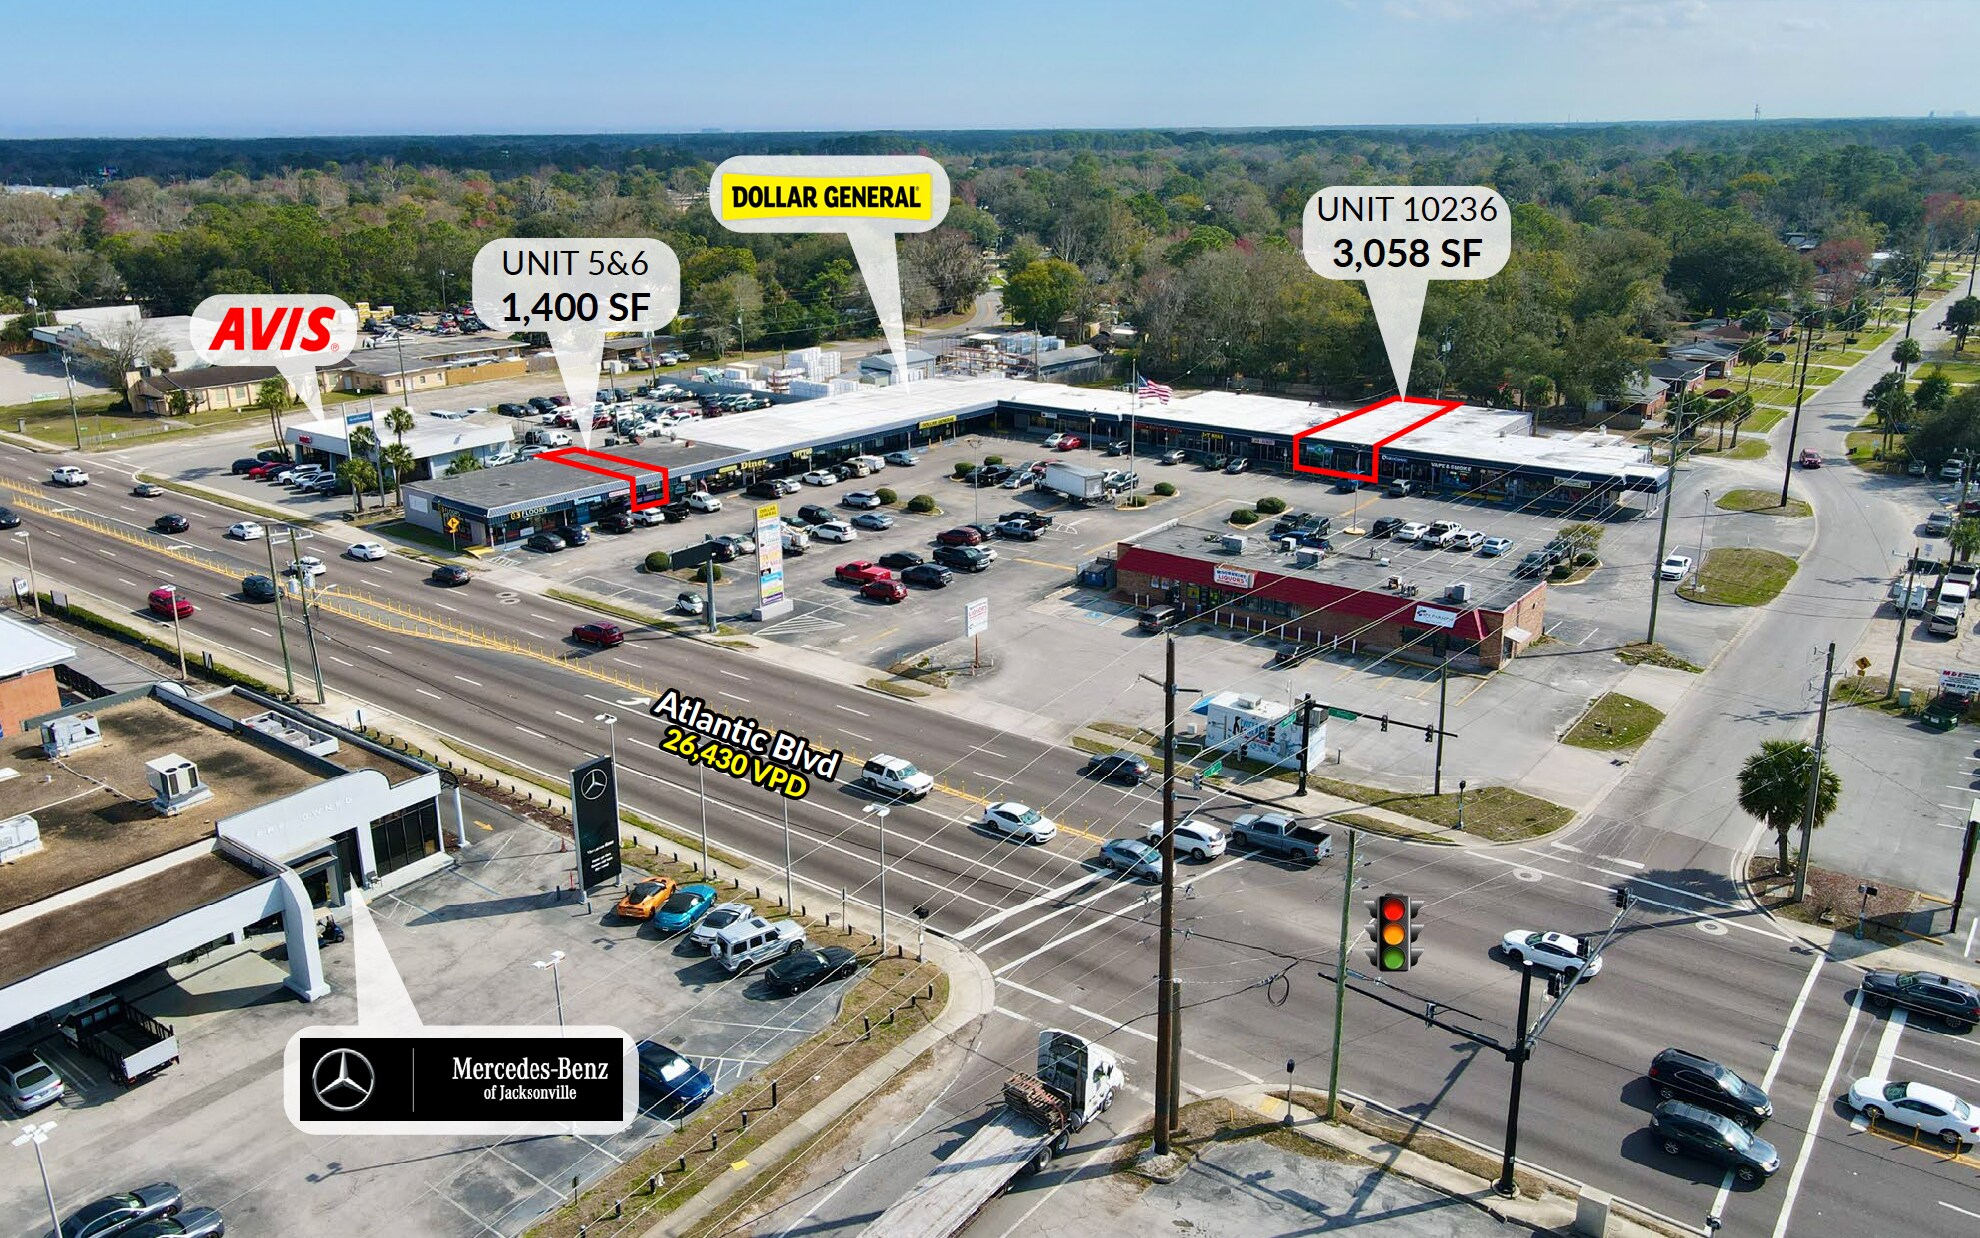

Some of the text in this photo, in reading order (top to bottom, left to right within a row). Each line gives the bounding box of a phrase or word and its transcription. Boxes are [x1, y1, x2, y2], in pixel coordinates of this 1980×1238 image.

[740, 458, 768, 471] Diner
[522, 506, 548, 518] FLOORS
[1218, 574, 1245, 584] LIQUORS
